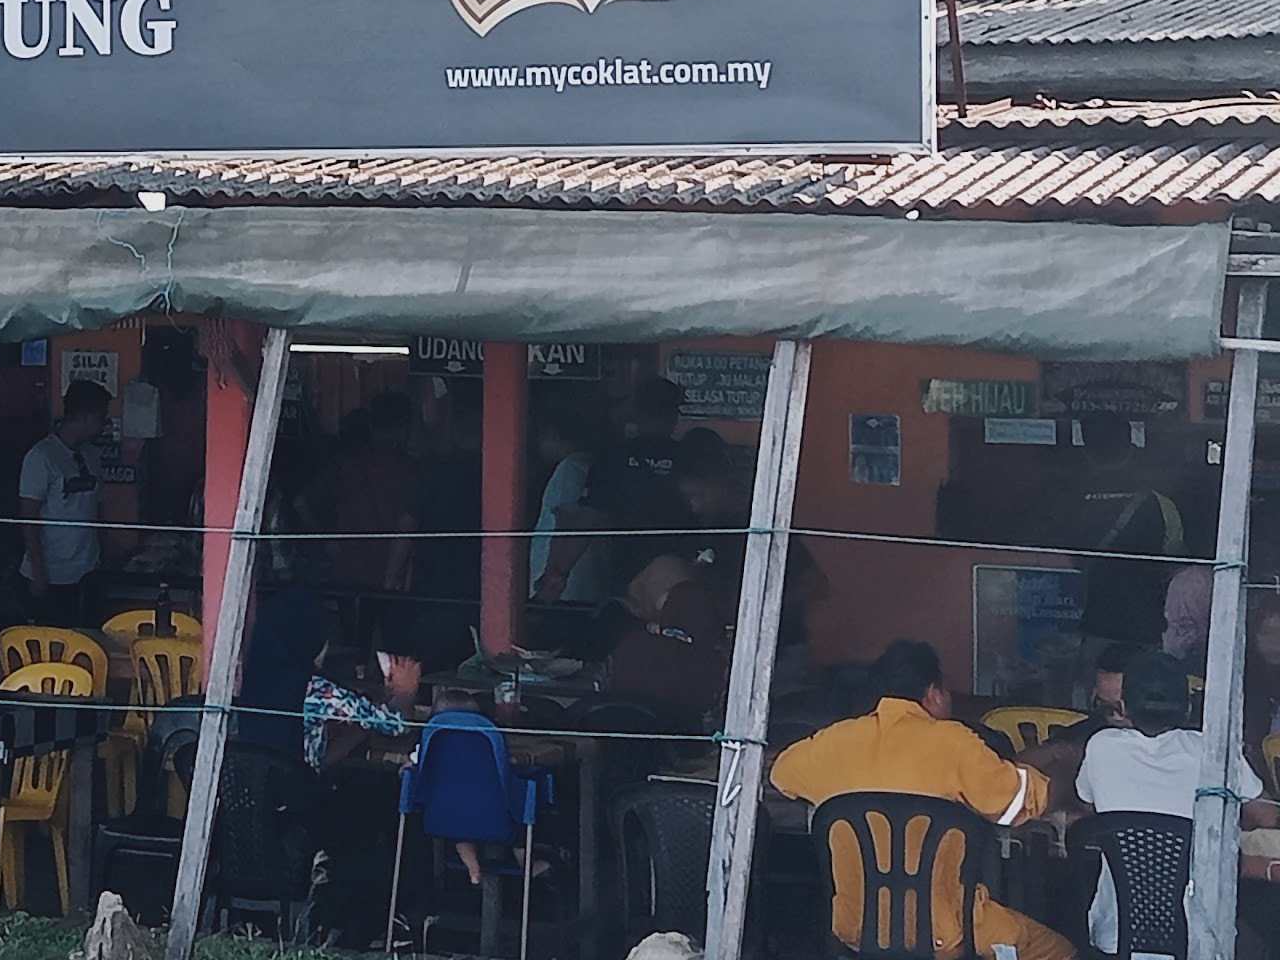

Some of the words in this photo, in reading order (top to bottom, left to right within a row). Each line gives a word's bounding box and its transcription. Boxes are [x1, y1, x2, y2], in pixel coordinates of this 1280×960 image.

[446, 59, 772, 92] www.mycoklat.com.my
[72, 354, 109, 369] SILA
[528, 343, 585, 364] KAN
